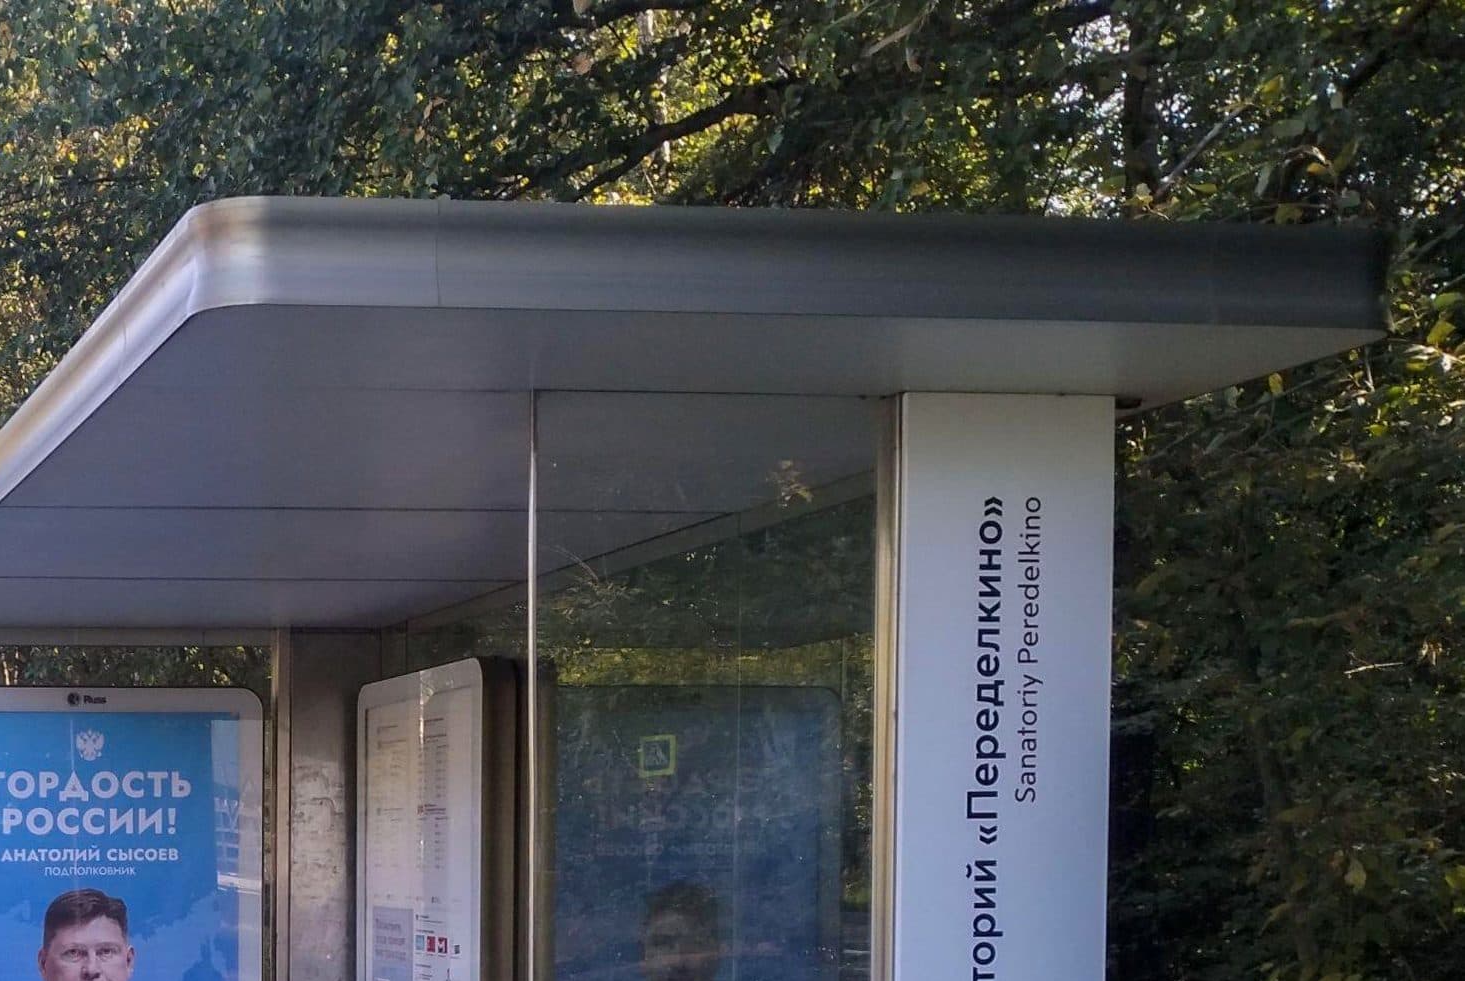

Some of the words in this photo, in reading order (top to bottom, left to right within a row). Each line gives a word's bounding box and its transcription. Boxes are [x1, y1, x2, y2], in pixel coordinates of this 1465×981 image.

[1017, 496, 1042, 664] Peredelkino
[966, 496, 1006, 845] «Переделкино»
[1015, 673, 1044, 803] Sanatoriy
[0, 845, 100, 862] АНАТОЛИЙ
[107, 848, 179, 862] СЫСОЕВ
[1, 806, 177, 836] РОССИИ!
[44, 865, 136, 877] ПОДПОЛКОВНИК
